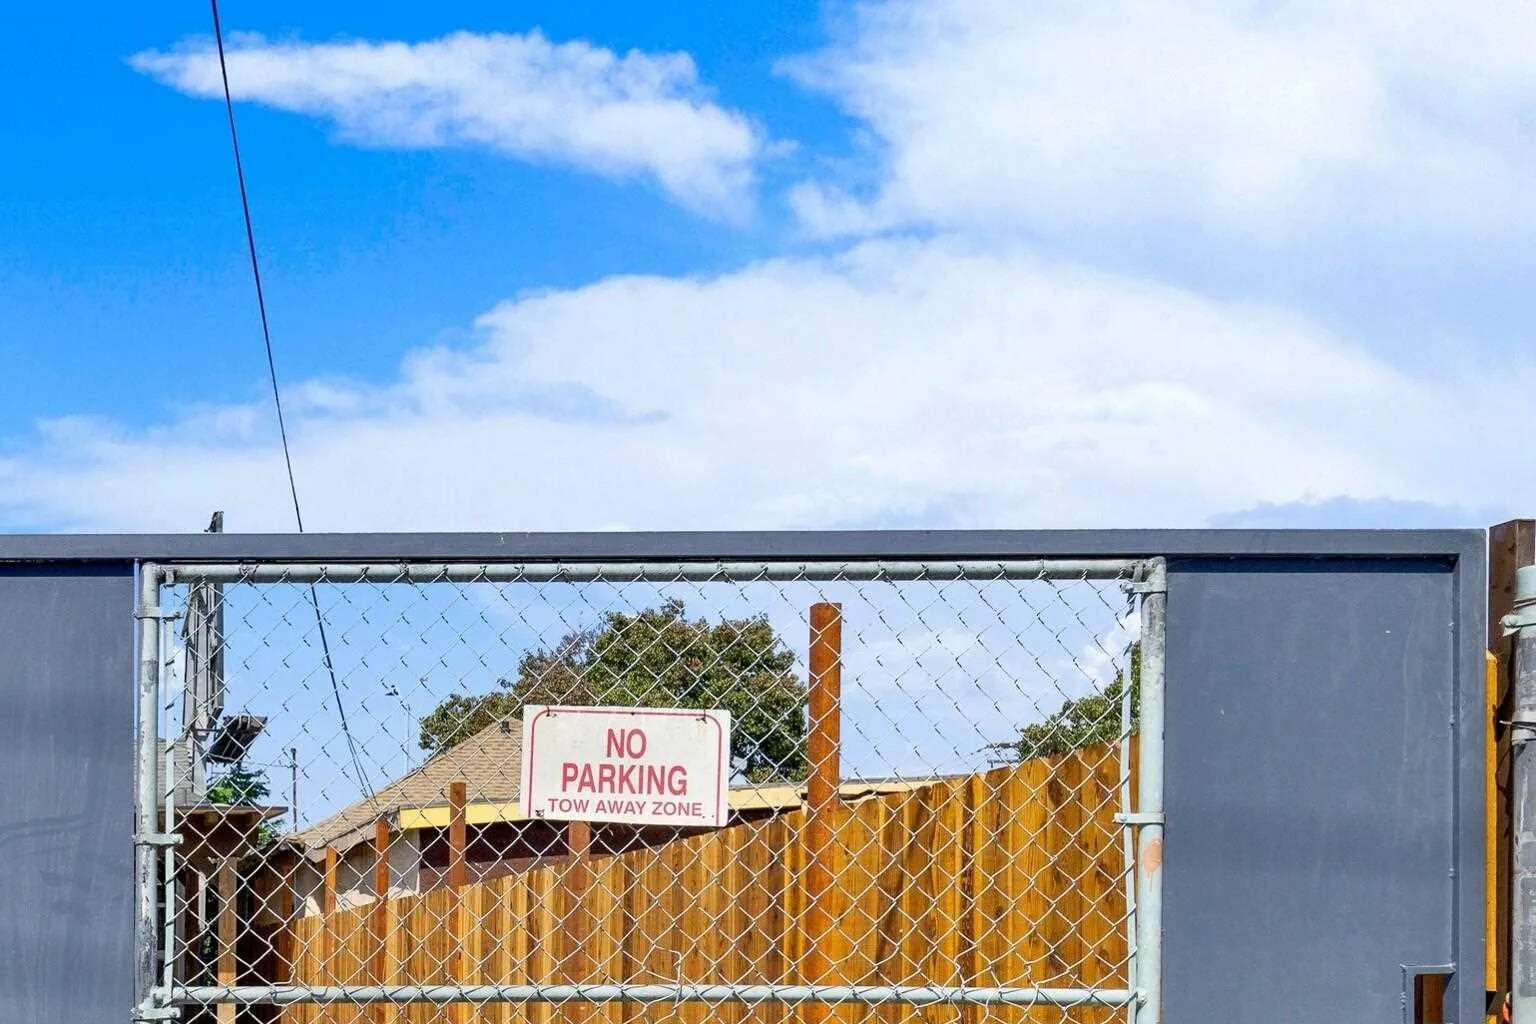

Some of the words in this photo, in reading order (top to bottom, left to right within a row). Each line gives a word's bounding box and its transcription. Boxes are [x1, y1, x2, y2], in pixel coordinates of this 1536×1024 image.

[606, 728, 647, 759] NO
[561, 763, 687, 796] PARKING
[548, 798, 590, 813] TOW
[595, 799, 647, 815] AWAY
[651, 801, 703, 816] ZONE
